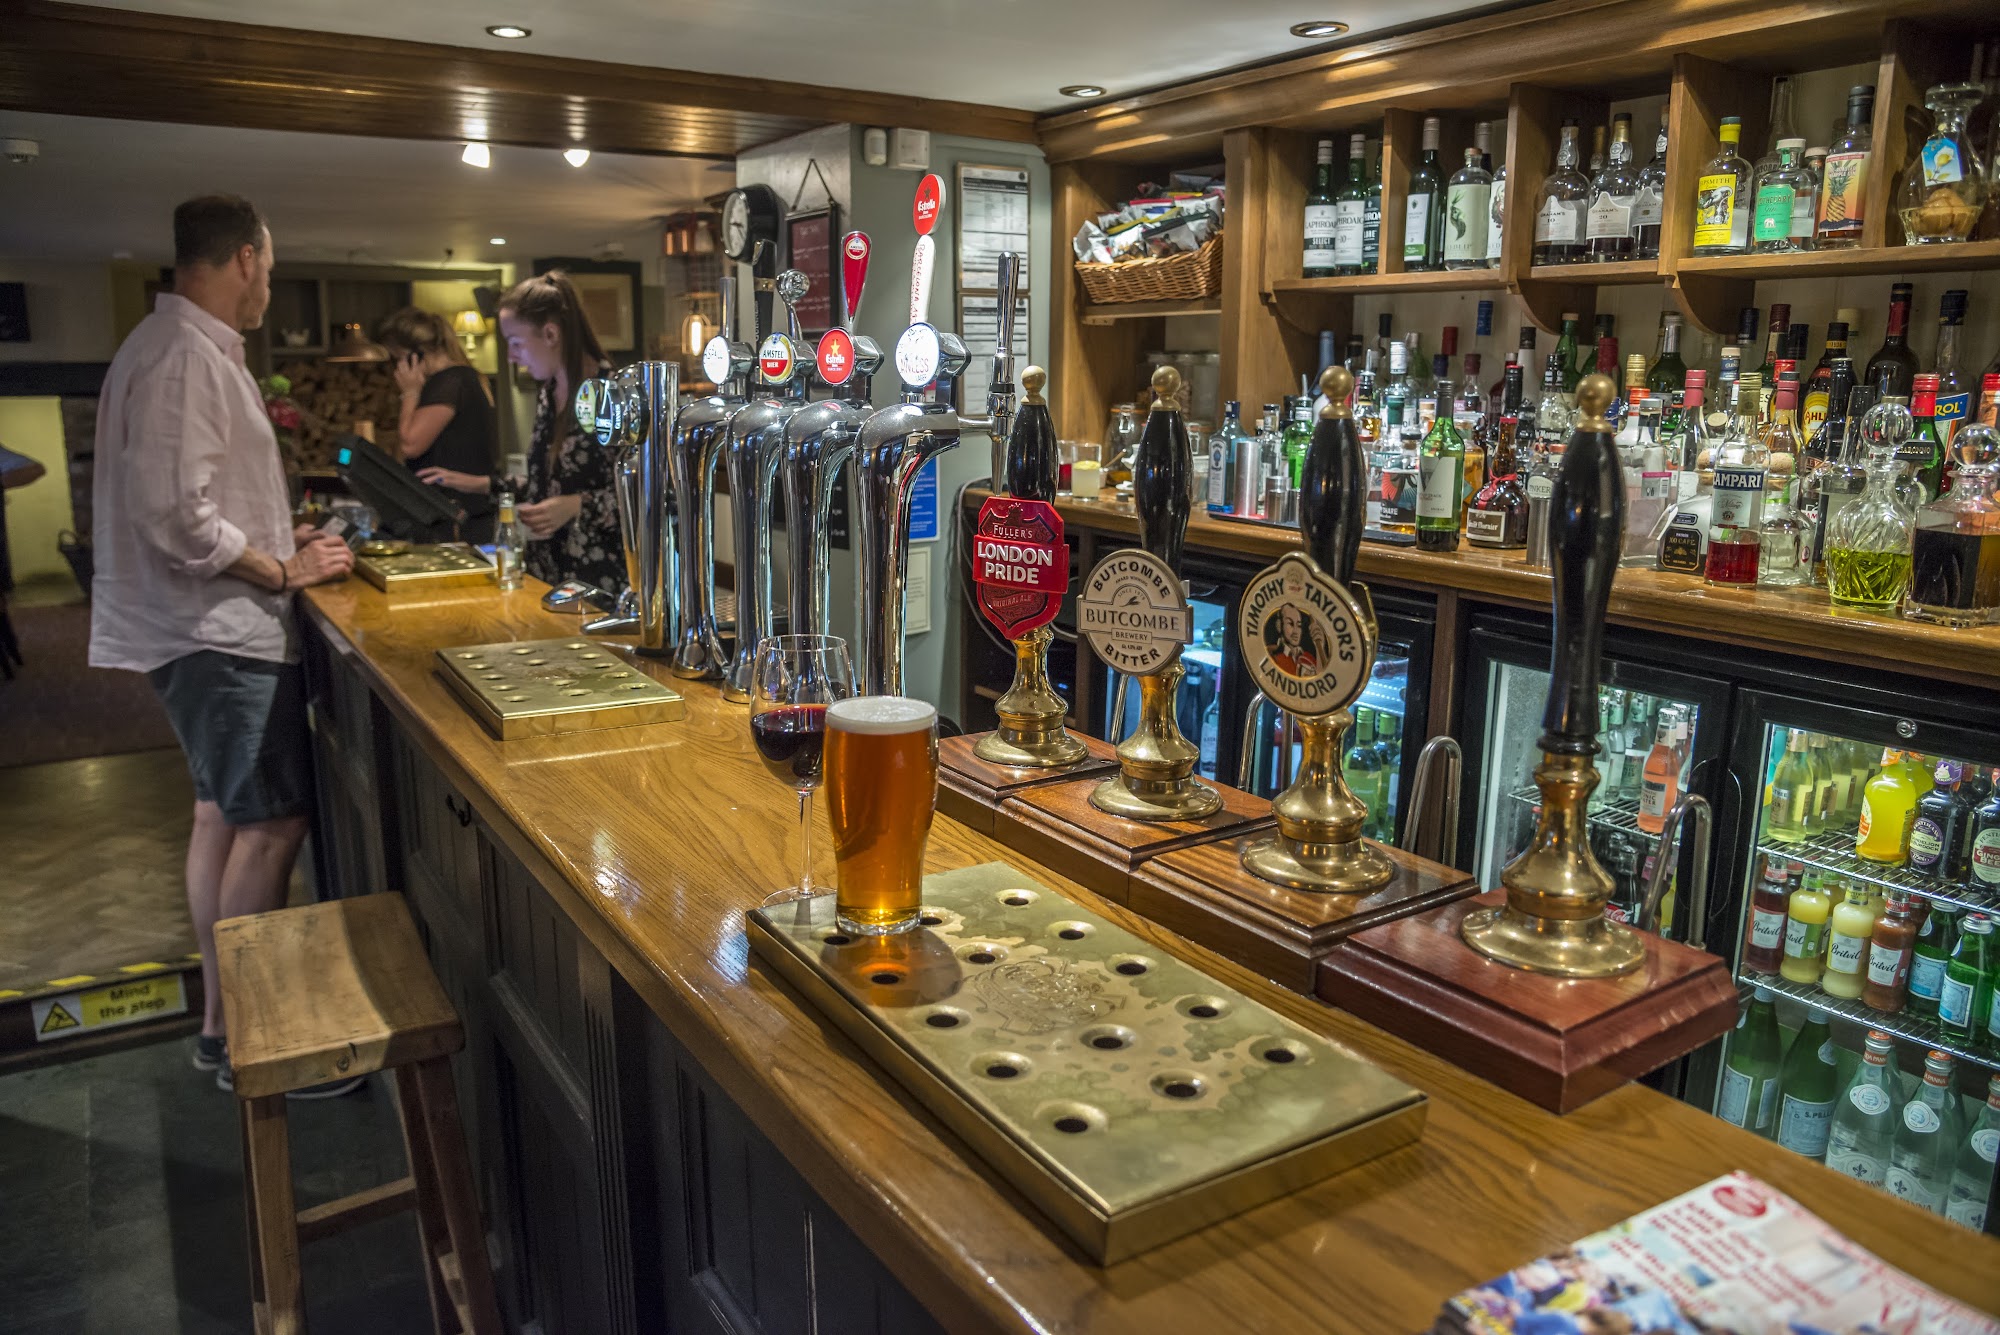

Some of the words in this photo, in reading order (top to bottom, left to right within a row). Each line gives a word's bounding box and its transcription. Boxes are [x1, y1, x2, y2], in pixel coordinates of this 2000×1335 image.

[762, 350, 784, 359] AMSTEL
[993, 525, 1033, 539] FULLER'S
[977, 541, 1053, 567] LONDON
[985, 562, 1040, 585] PRIDE
[1093, 561, 1171, 599] BUTCOMBE
[1086, 608, 1180, 631] BUTCOMBE
[1247, 578, 1285, 637] TIMOTHY
[1305, 582, 1355, 663] TAYLOR'S
[1115, 631, 1148, 641] BREWERY
[1104, 643, 1161, 666] BITTER
[1259, 657, 1337, 699] LANDLORD
[1752, 920, 1781, 936] Britvic
[1831, 943, 1862, 961] Britvic
[1869, 952, 1898, 973] Britvic
[110, 985, 151, 1002] Mind
[100, 1005, 125, 1018] the
[130, 998, 167, 1015] step
